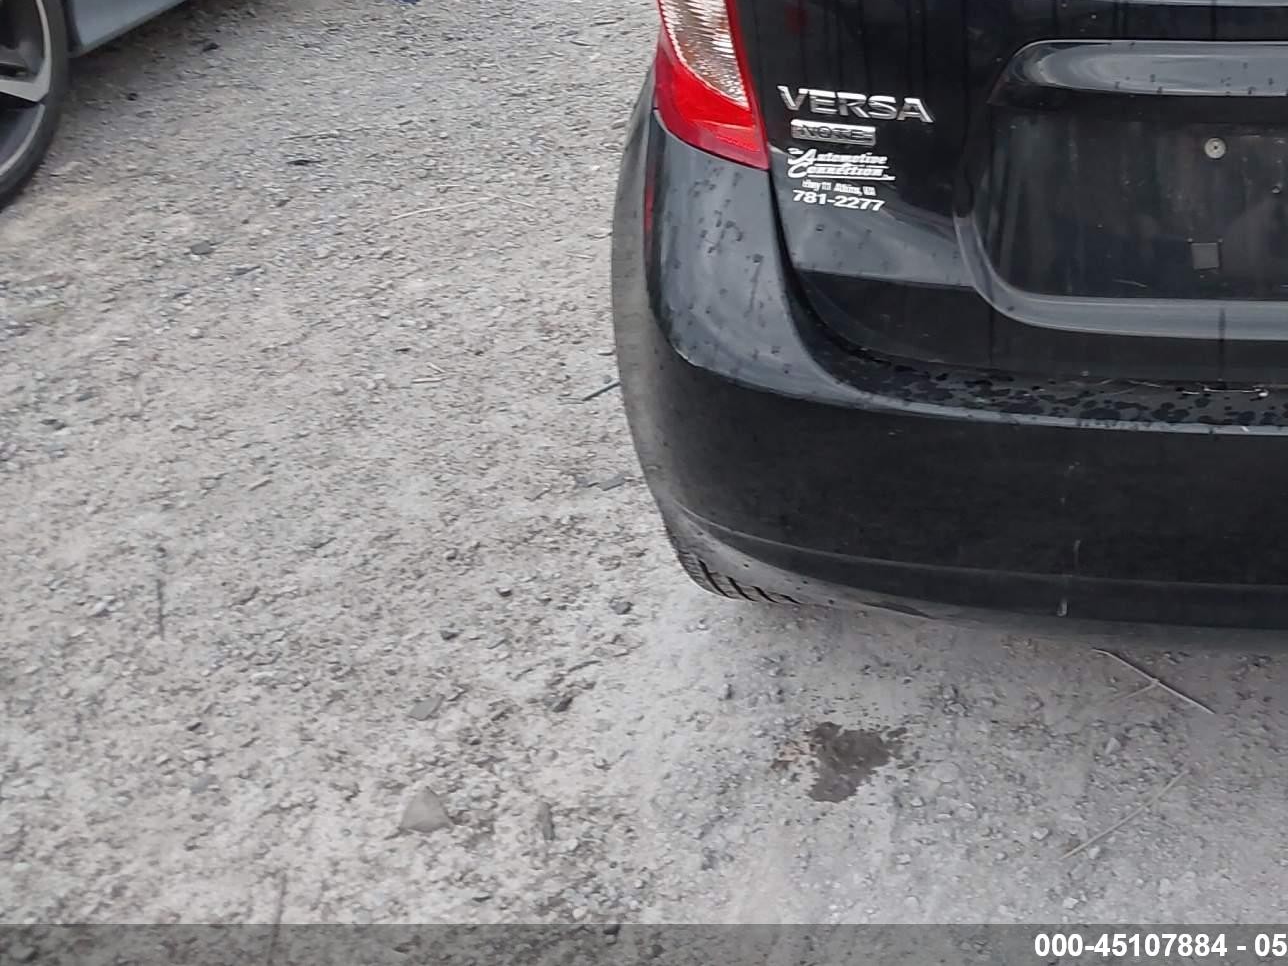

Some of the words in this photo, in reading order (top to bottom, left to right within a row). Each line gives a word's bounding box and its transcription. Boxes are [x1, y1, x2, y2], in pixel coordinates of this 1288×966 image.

[776, 84, 934, 124] VERSA
[799, 123, 873, 141] NOTE
[787, 147, 888, 165] Automotive
[792, 189, 886, 211] 781-2277
